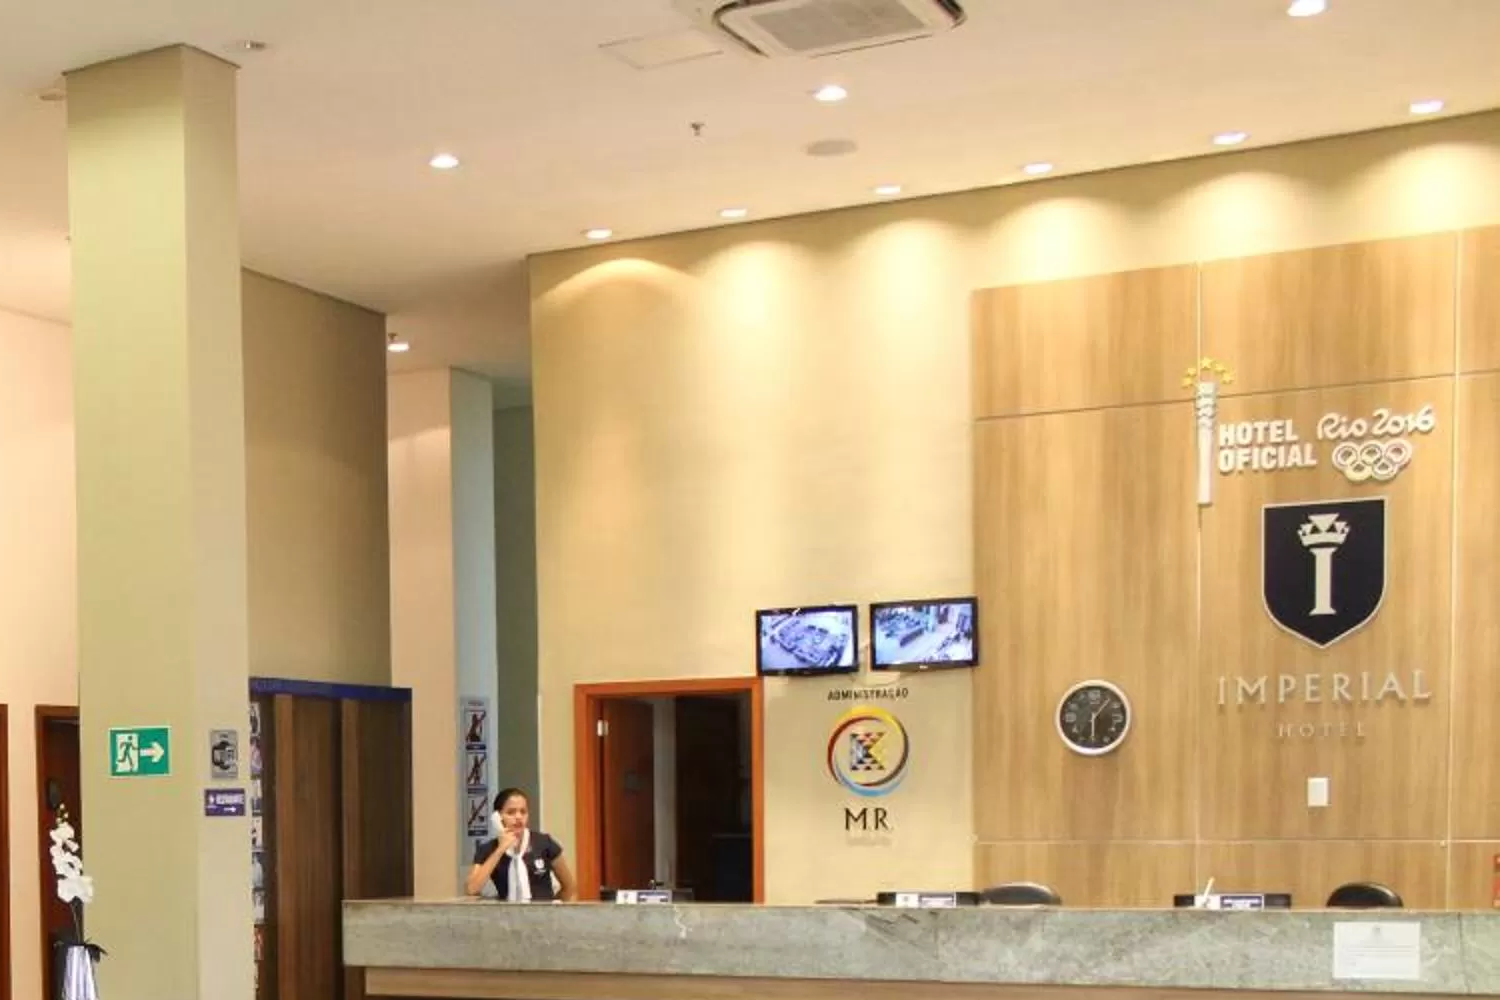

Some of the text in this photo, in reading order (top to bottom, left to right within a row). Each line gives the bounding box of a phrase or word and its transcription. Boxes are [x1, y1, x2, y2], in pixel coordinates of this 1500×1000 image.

[1218, 419, 1299, 446] HOTEL
[1316, 405, 1436, 440] Rio 2016
[1218, 443, 1318, 473] OFICIAL
[1216, 668, 1433, 706] IMPERIAL
[1277, 721, 1368, 738] HOTEL
